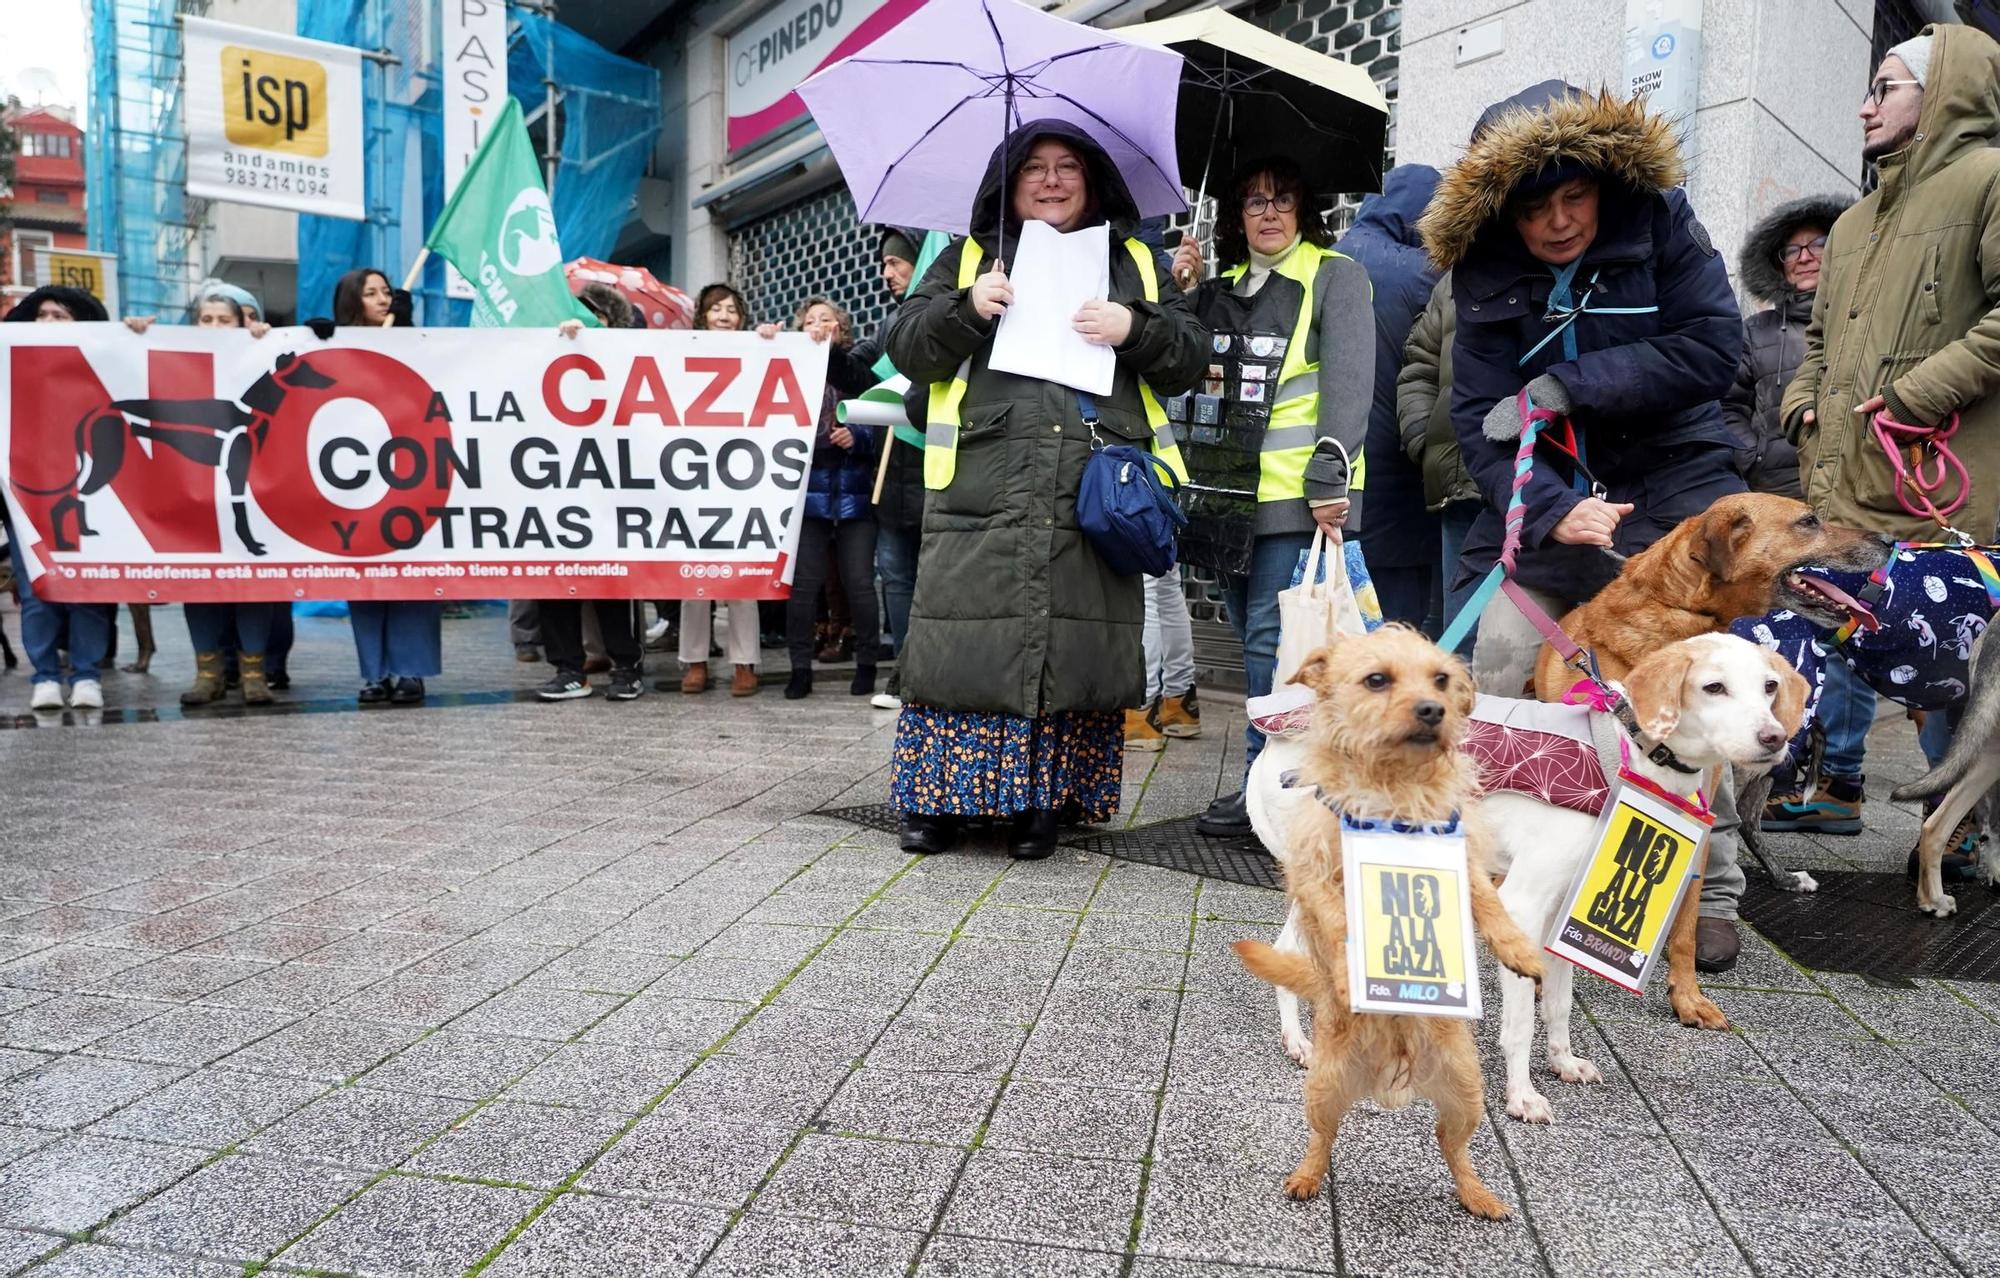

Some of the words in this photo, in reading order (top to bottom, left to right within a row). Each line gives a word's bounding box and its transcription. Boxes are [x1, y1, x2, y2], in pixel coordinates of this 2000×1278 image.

[1631, 69, 1662, 86] SKOW
[1631, 80, 1662, 97] SKOW
[242, 59, 309, 141] isp
[223, 151, 330, 179] andamios
[225, 167, 257, 187] 983
[263, 173, 290, 192] 214
[296, 179, 328, 195] 094
[424, 391, 453, 422] A
[469, 391, 525, 422] LA
[541, 353, 812, 427] CAZA
[9, 345, 454, 557] NO
[319, 436, 482, 490] CON
[510, 436, 809, 491] GALGOS
[331, 521, 359, 550] Y
[380, 505, 594, 549] OTRAS
[80, 565, 121, 579] más
[124, 565, 212, 579] indefensa
[215, 565, 252, 579] está
[256, 567, 288, 579] una
[291, 565, 361, 580] criatura,
[364, 565, 398, 578] más
[401, 564, 465, 578] derecho
[468, 564, 509, 577] tiene
[512, 567, 522, 577] a
[526, 566, 551, 577] ser
[554, 563, 628, 577] defendida
[1613, 816, 1679, 885] NO
[1380, 871, 1441, 919] NO
[1587, 890, 1646, 946] CAZA
[1382, 944, 1446, 978] CAZA
[1564, 926, 1583, 943] Fdo.
[1583, 933, 1630, 964] BRANDY
[1369, 984, 1391, 997] Fdo.
[1398, 983, 1439, 1001] MILO
